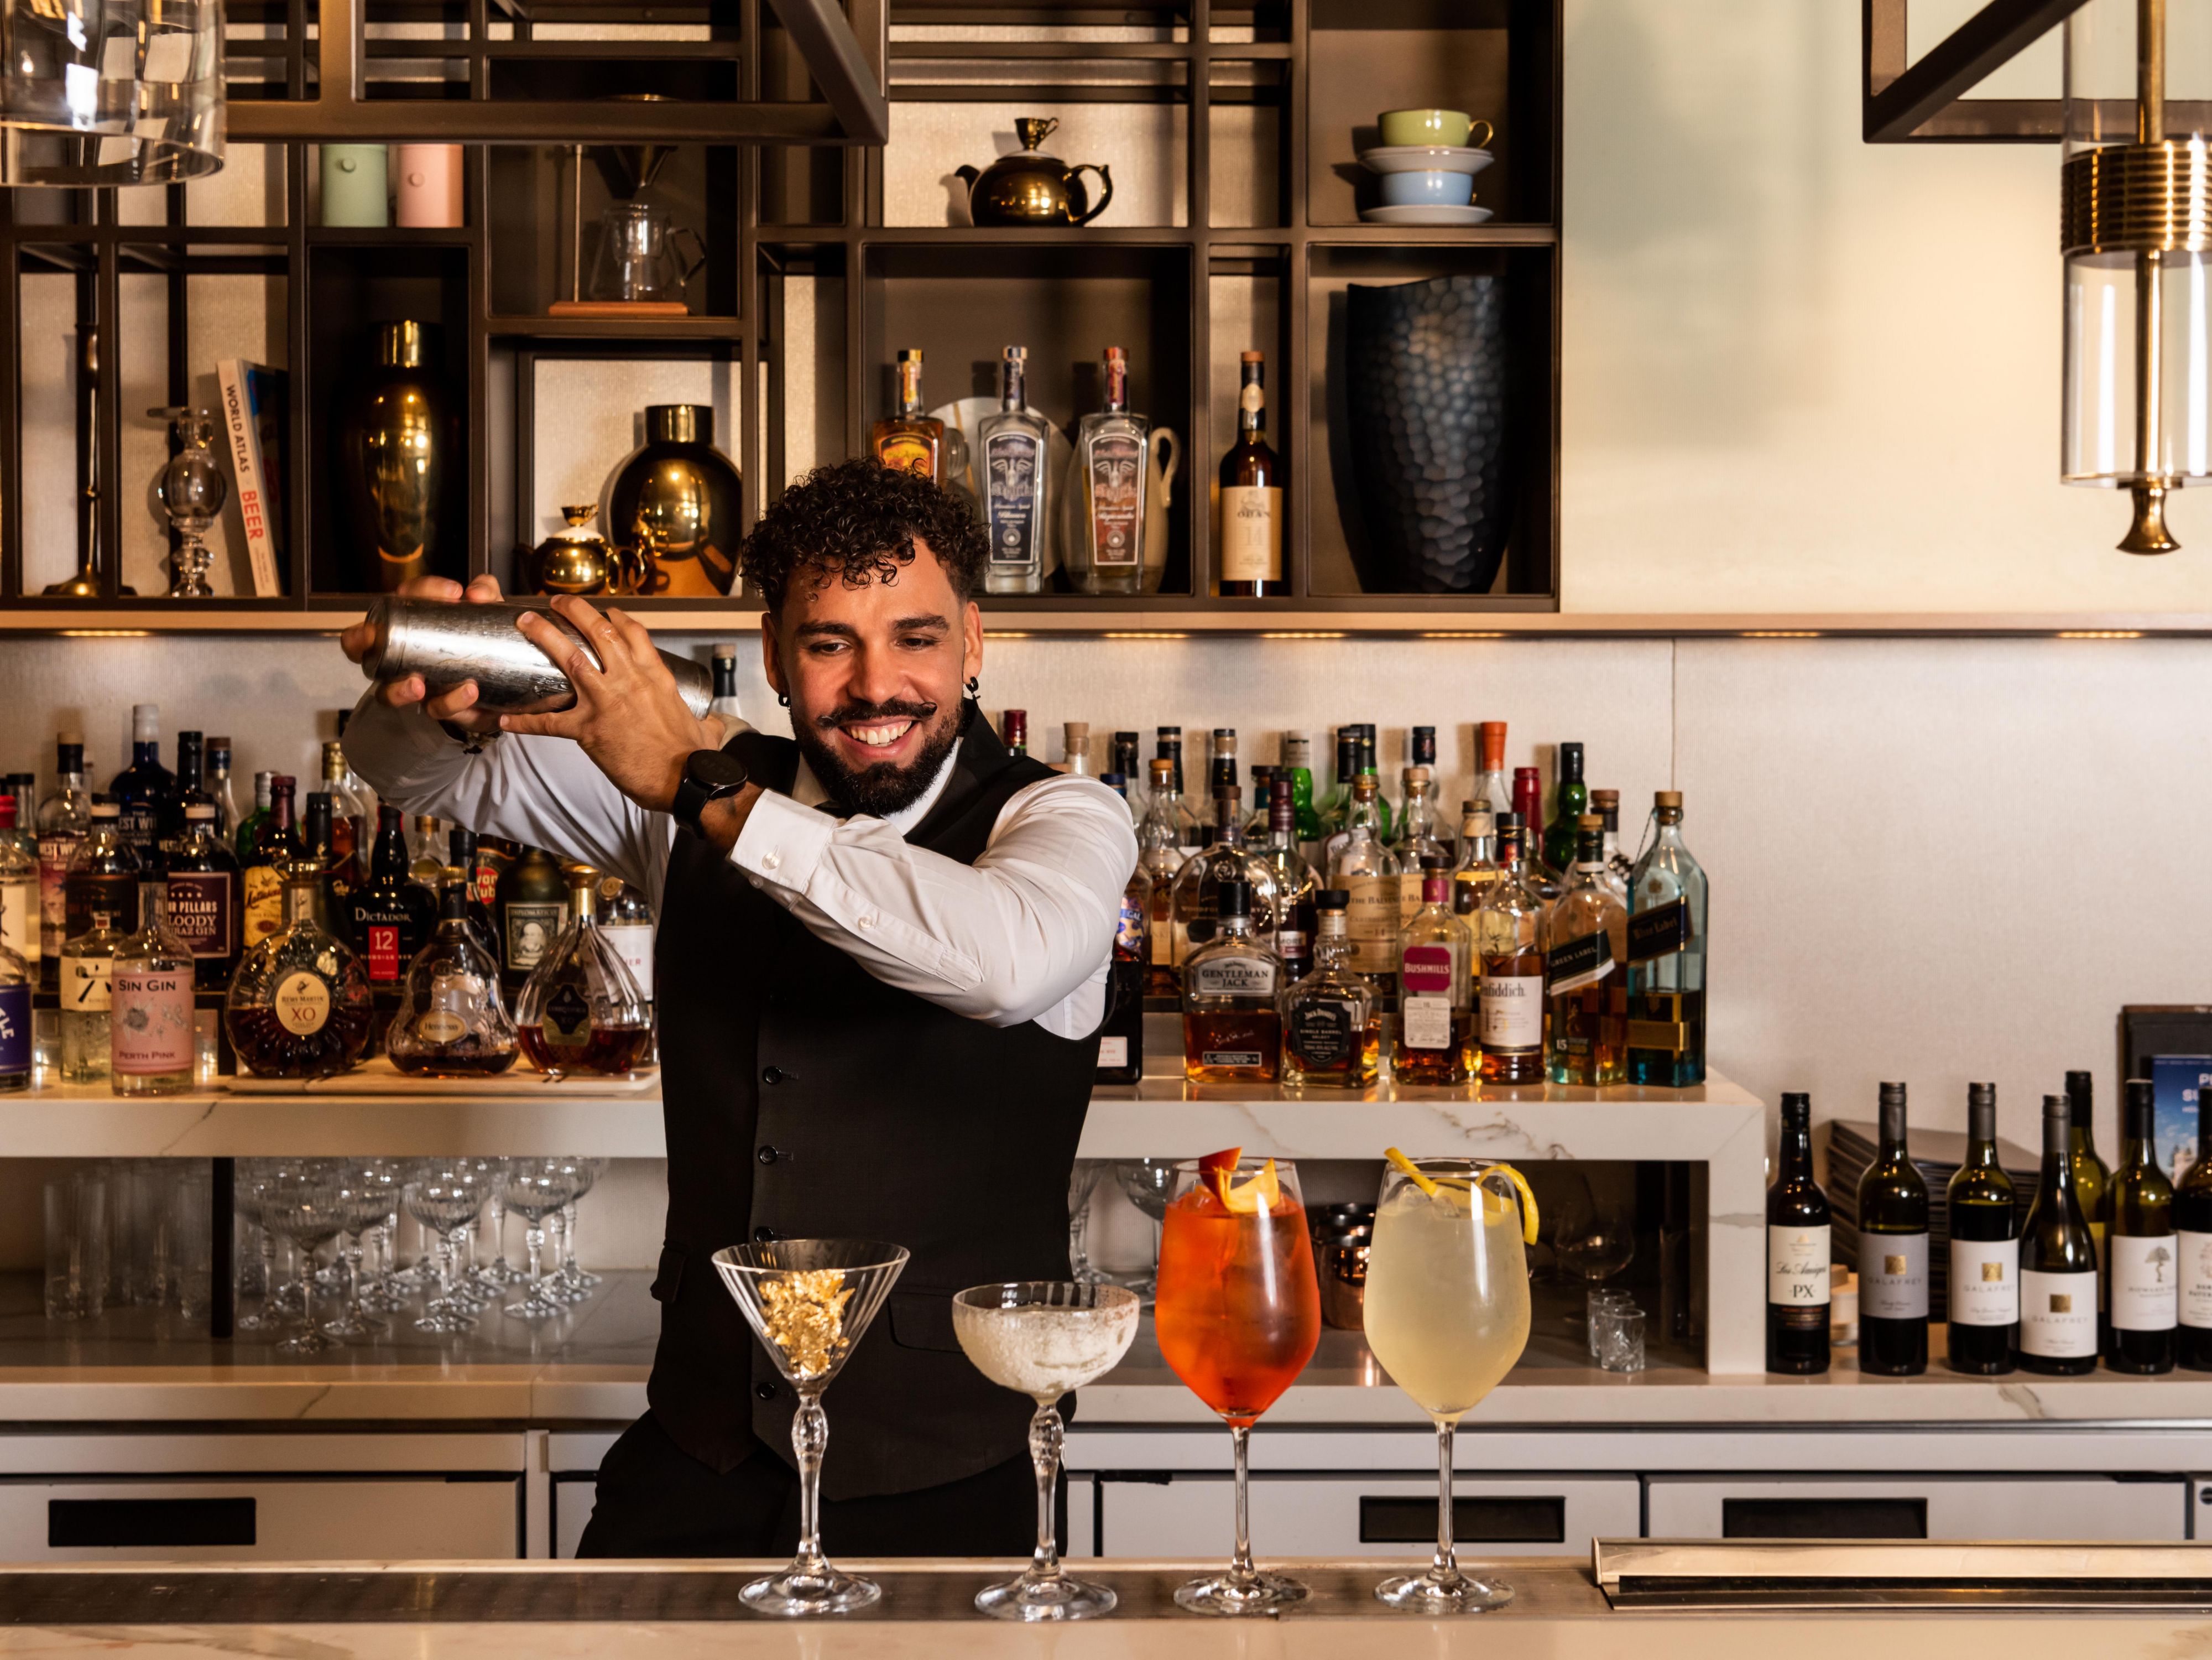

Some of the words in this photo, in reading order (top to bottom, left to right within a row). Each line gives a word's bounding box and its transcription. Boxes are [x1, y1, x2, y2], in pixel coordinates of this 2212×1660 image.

[227, 384, 242, 432] WORLD
[234, 435, 249, 473] ATLAS
[241, 490, 264, 540] BEER
[179, 901, 217, 913] PILLARS
[196, 927, 216, 936] GIN
[374, 930, 393, 951] 12
[1202, 969, 1269, 978] GENTLEMAN
[1405, 962, 1449, 974] BUSHMILLS
[1222, 979, 1248, 987] JACK
[291, 1007, 316, 1022] XO
